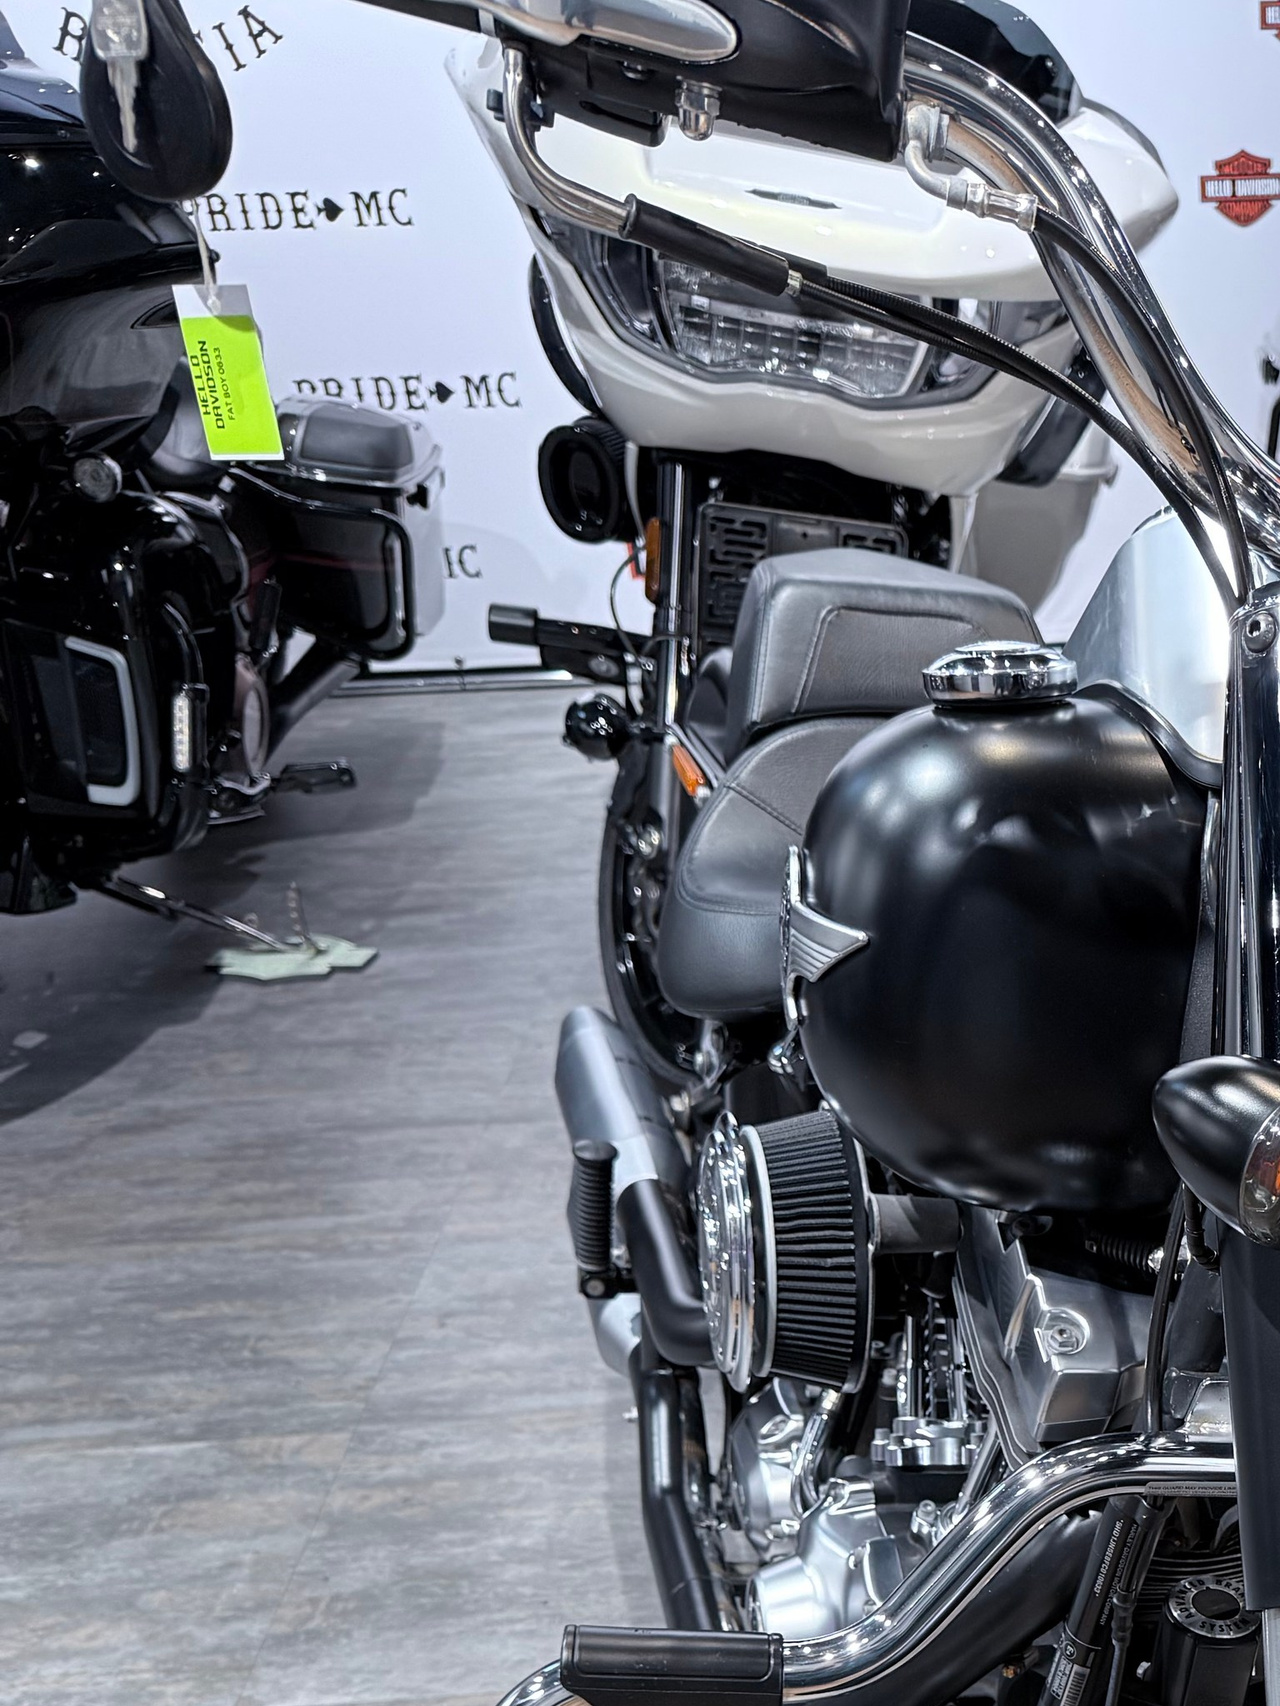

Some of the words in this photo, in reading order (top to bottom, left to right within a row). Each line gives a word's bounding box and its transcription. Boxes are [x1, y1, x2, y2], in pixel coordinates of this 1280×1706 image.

[52, 5, 283, 71] RIA
[349, 188, 414, 227] MC
[190, 355, 211, 415] HELLO
[198, 340, 225, 429] DAVIDSON
[220, 377, 231, 399] BOY
[460, 372, 522, 408] MC
[225, 402, 235, 420] FAT
